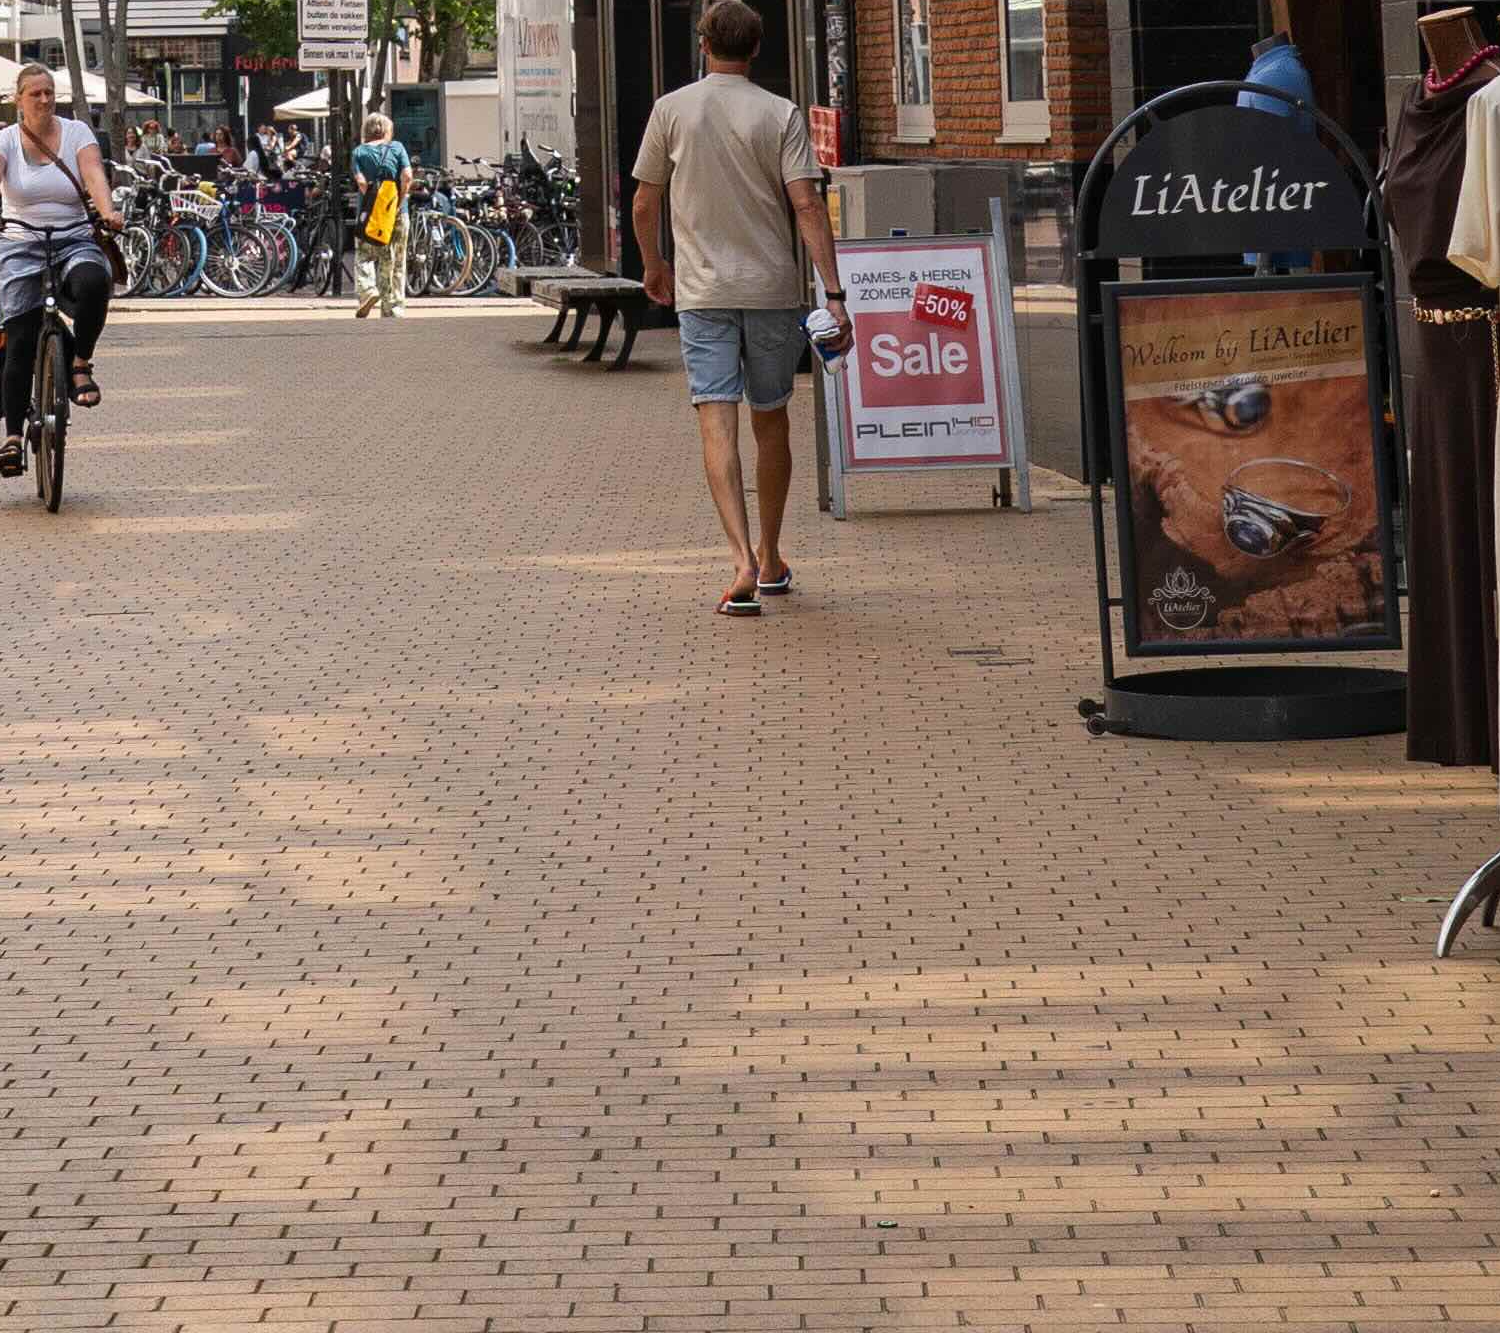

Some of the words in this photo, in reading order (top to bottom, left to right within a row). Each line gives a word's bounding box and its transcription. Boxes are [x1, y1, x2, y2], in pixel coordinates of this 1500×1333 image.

[1131, 165, 1329, 216] LiAtelier
[850, 270, 906, 284] DAMES-
[909, 271, 918, 282] &
[922, 268, 972, 282] HEREN
[870, 332, 969, 377] Sale
[1125, 334, 1205, 368] Welkom
[1215, 330, 1240, 367] bij
[1250, 316, 1358, 353] LiAtelier
